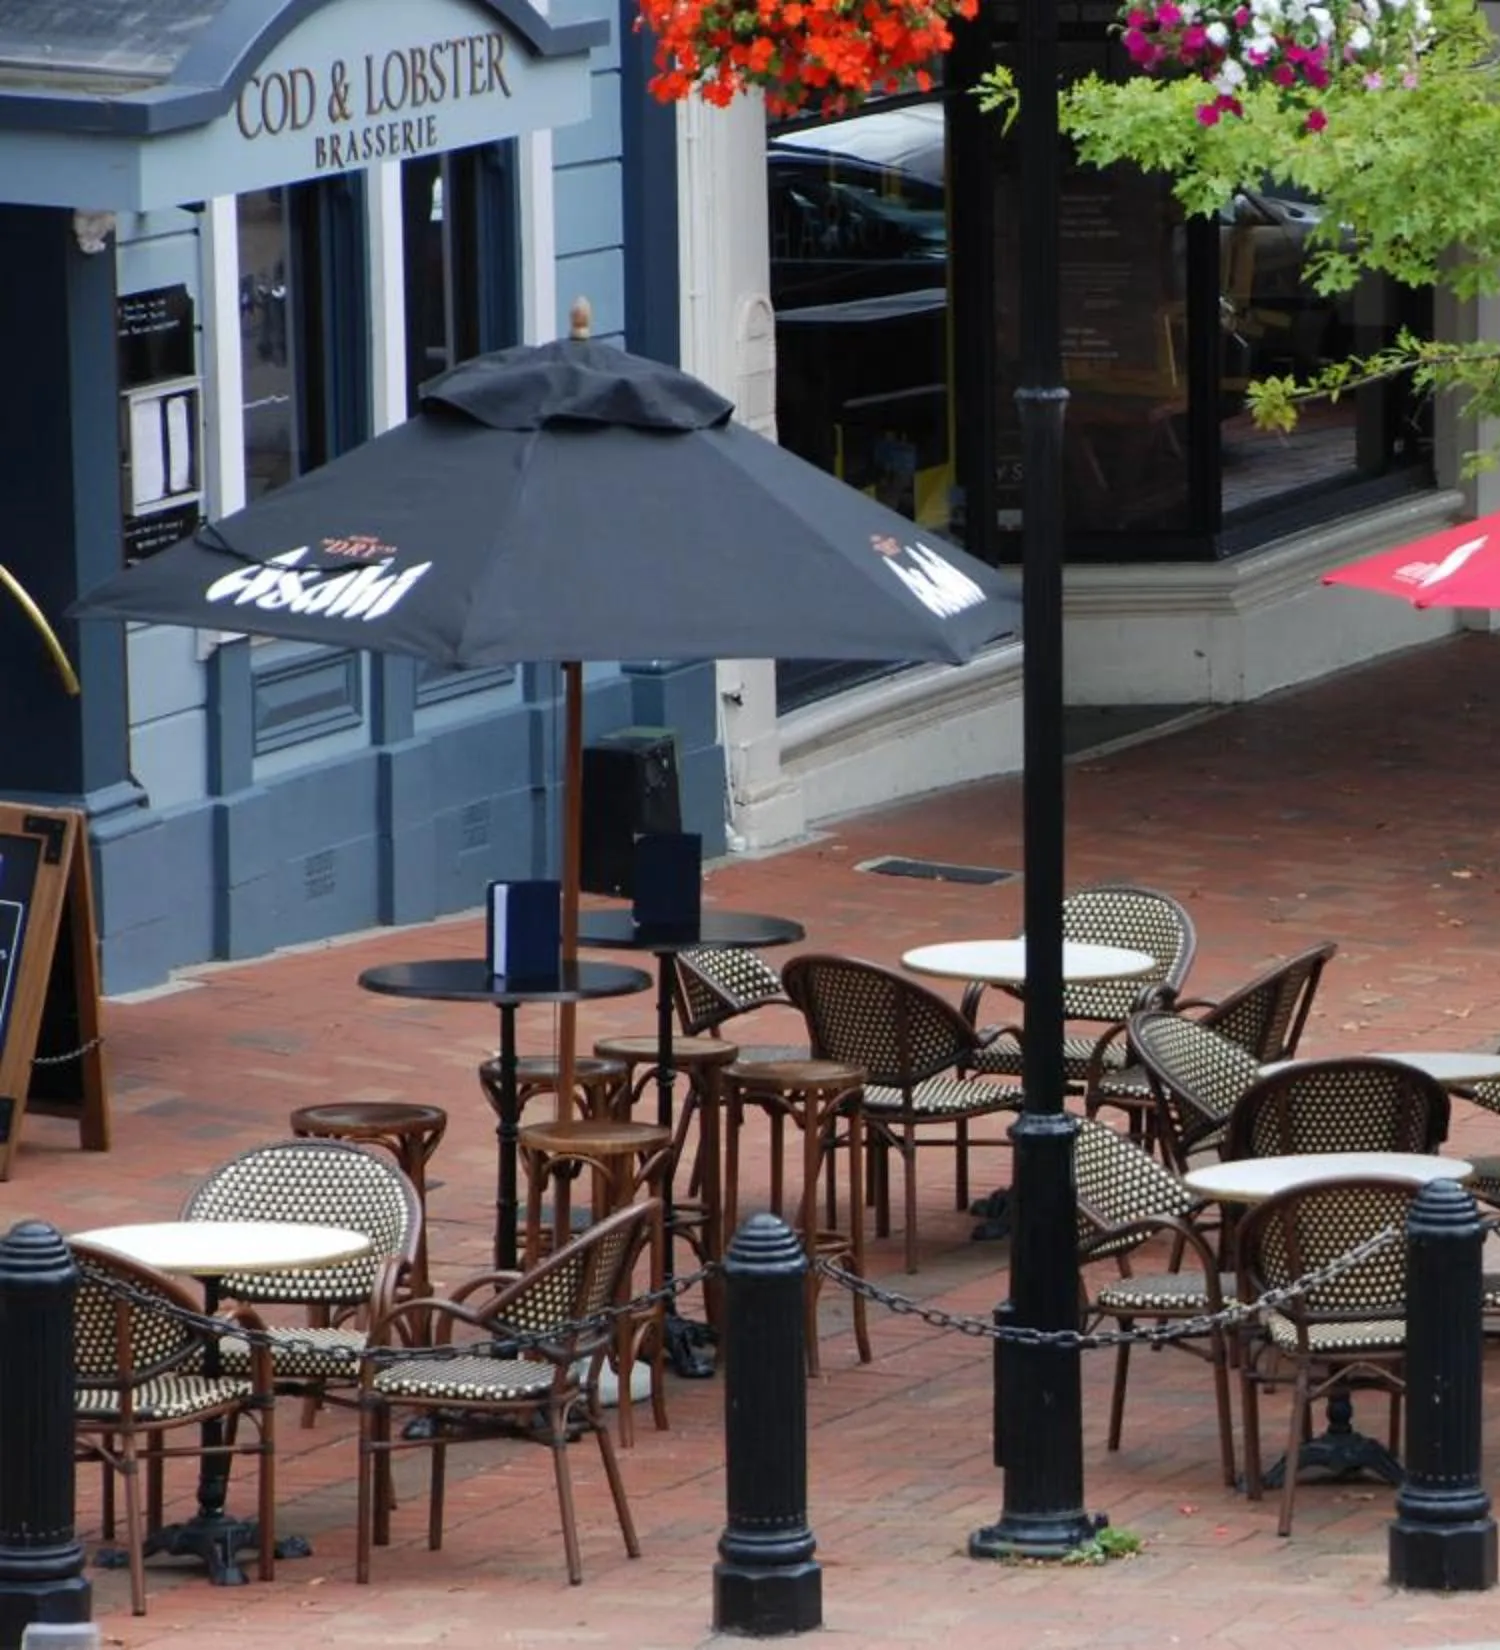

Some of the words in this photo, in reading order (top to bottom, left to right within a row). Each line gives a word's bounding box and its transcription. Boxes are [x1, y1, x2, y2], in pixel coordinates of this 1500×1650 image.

[237, 67, 316, 140] COD
[327, 59, 353, 124] &
[364, 31, 512, 115] LOBSTER
[314, 115, 438, 169] BRASSERIE
[205, 545, 433, 622] Asahi
